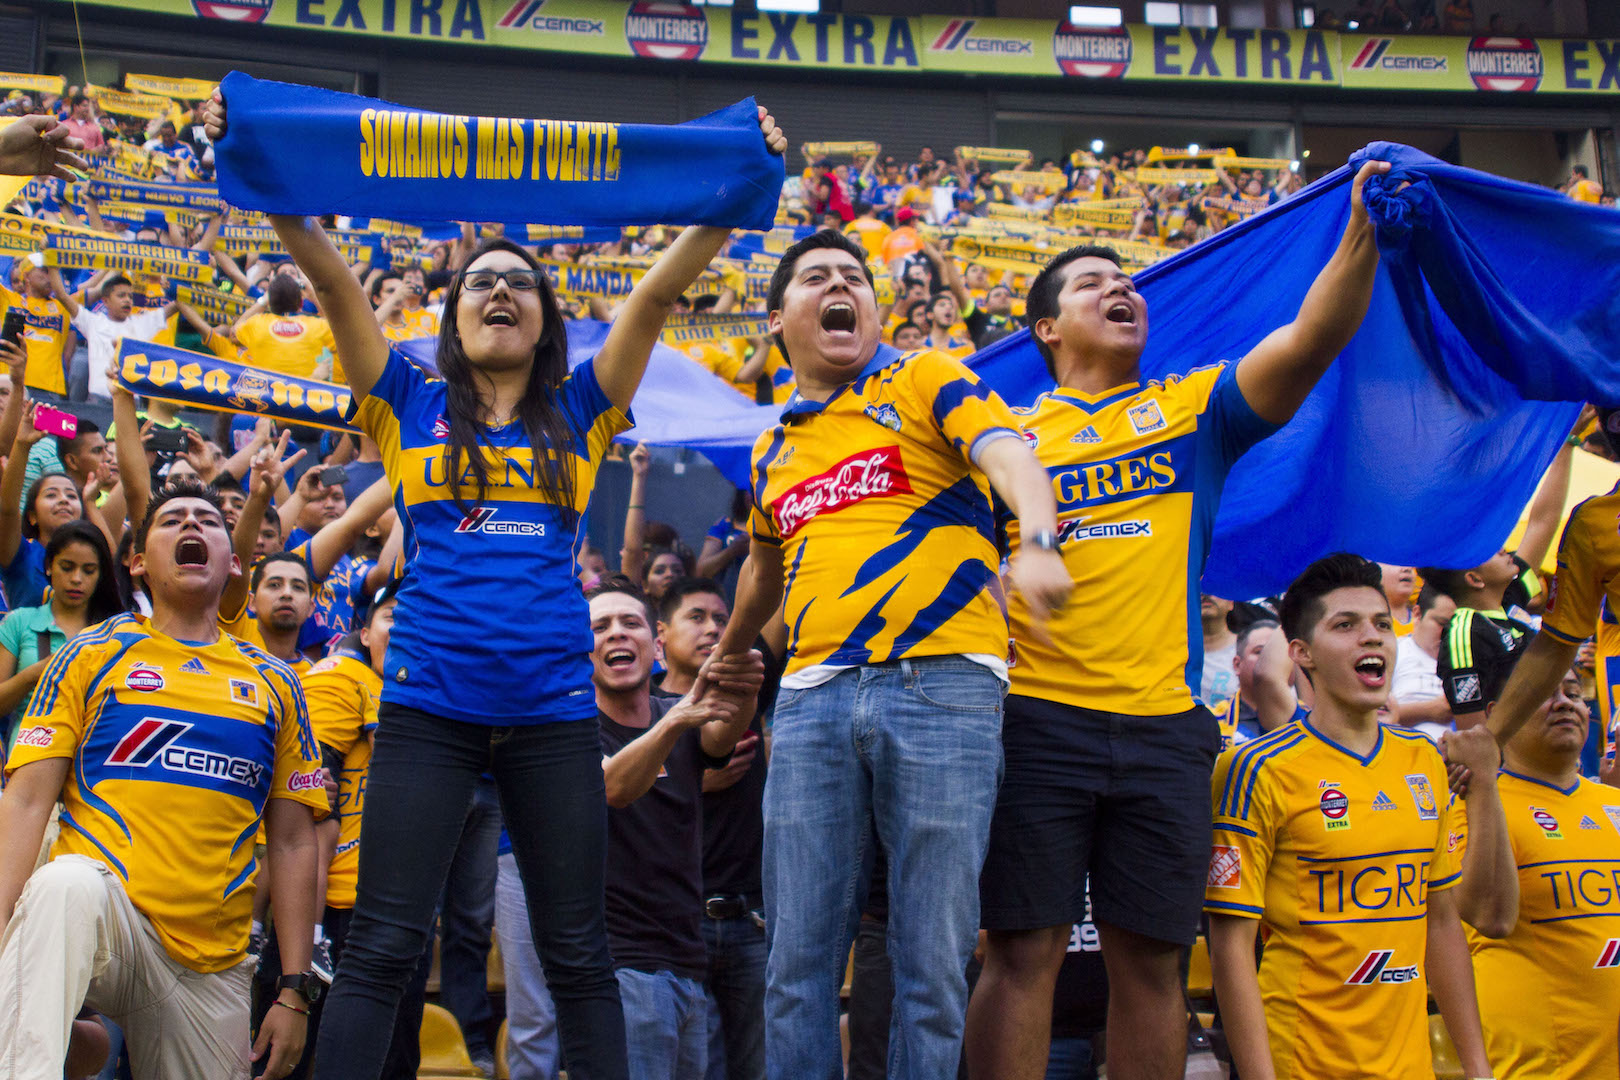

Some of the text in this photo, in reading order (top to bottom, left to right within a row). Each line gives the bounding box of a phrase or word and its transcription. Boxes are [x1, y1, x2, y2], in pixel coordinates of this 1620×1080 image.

[296, 0, 486, 40] EXTRA
[532, 16, 603, 33] CEMEX
[627, 15, 706, 42] MONTERREY
[730, 9, 919, 66] EXTRA
[964, 38, 1032, 54] CEMEX
[1055, 35, 1130, 60] MONTERREY
[1153, 26, 1333, 80] EXTRA
[1382, 56, 1447, 70] CEMEX
[1469, 51, 1541, 74] MONTERREY
[360, 108, 621, 181] SONAMOS MAS FUERTE
[145, 192, 185, 203] NUEVO
[56, 236, 201, 263] INCOMPARABLE
[57, 252, 199, 279] HAY UNA SOLA
[566, 267, 634, 298] MANDA
[1052, 451, 1176, 504] GRES
[779, 453, 893, 535] Coca-Cola
[485, 523, 546, 535] CEMEX
[1075, 522, 1150, 539] CEMEX
[126, 677, 163, 687] MONTERREY
[164, 748, 265, 786] CEMEX
[1320, 798, 1348, 810] MONTERREY
[1327, 820, 1348, 829] EXTRA
[1309, 862, 1430, 913] TIGRE
